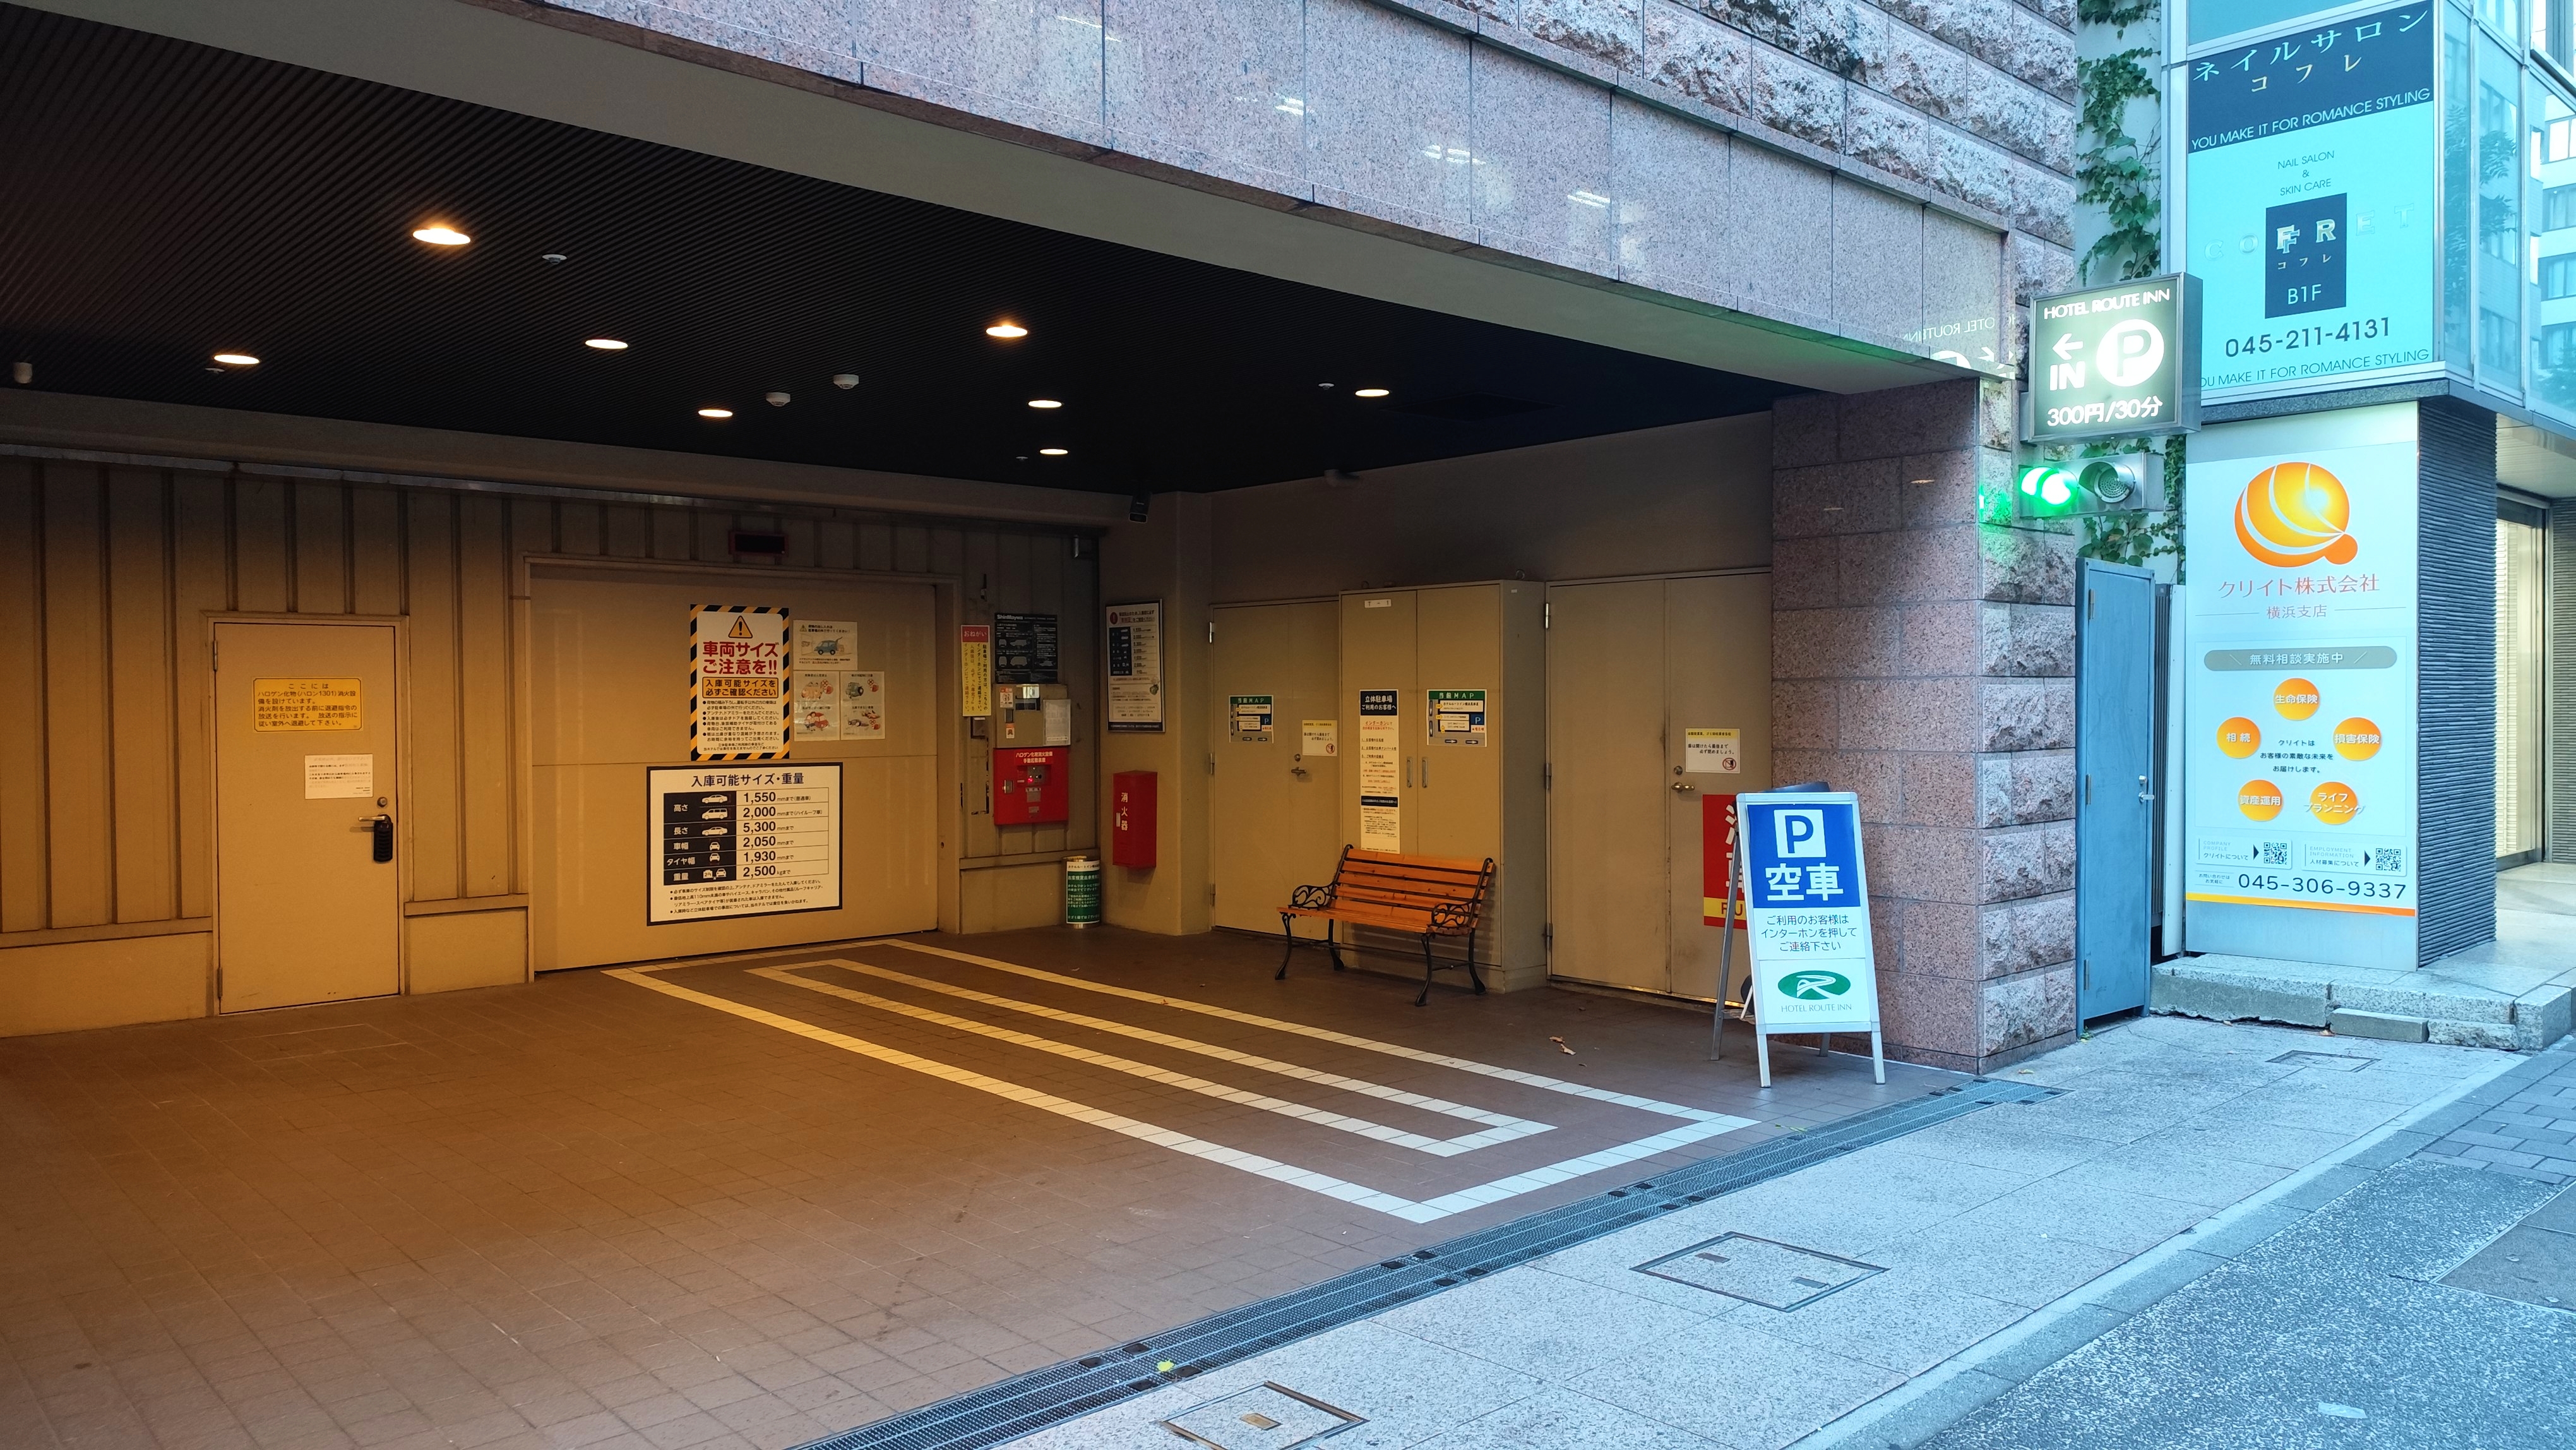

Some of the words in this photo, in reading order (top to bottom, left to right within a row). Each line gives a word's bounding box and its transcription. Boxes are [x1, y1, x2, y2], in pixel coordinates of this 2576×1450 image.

[2193, 9, 2428, 81] ネイルサロン
[2251, 54, 2361, 92] コフレ
[2191, 135, 2217, 150] YOU
[2221, 128, 2254, 144] MAKE
[2258, 123, 2268, 136] IT
[2272, 117, 2298, 133] FOR
[2303, 100, 2371, 126] ROMANCE
[2376, 88, 2430, 111] STYLING
[2277, 157, 2298, 169] NAIL
[2302, 150, 2334, 162] SALON
[2303, 169, 2310, 178] &
[2280, 184, 2301, 196] SKIN
[2305, 179, 2332, 191] CARE
[2277, 254, 2332, 270] コフレ
[2287, 284, 2322, 304] B1F
[2044, 301, 2089, 320] HOTEL
[2092, 293, 2140, 313] ROUTE
[2143, 289, 2169, 305] INN
[2226, 317, 2389, 357] 045-211-4131
[2219, 371, 2251, 385] MAKE
[2257, 369, 2266, 380] IT
[2270, 366, 2296, 378] FOR
[2301, 356, 2370, 375] ROMANCE
[2375, 349, 2429, 366] STYLING
[2050, 361, 2085, 391] IN
[2047, 395, 2162, 426] 300円/30分
[2219, 573, 2380, 598] クリイト株式会社
[2267, 604, 2327, 620] 横浜支店
[703, 641, 779, 657] 車両サイズ
[2250, 652, 2344, 665] 無料相談実施中
[703, 659, 777, 675] ご注意を!!
[706, 679, 776, 688] 入庫可能サイズを
[706, 688, 776, 697] 必ずご確認ください
[1365, 695, 1393, 703] 立体駐車場
[2275, 694, 2318, 704] 生命保険
[2226, 733, 2251, 743] 相続
[2335, 734, 2380, 744] 損害保険
[691, 772, 804, 788] 入庫可能サイズ・重量
[744, 792, 776, 805] 1,550
[2240, 794, 2281, 806] 資産運用
[2318, 792, 2348, 802] ライフ
[673, 803, 689, 812] 高さ
[742, 806, 776, 820] 2,000
[742, 821, 776, 834] 5,300
[1785, 815, 1814, 853] P
[742, 836, 776, 849] 2,050
[667, 857, 695, 866] タイヤ幅
[743, 851, 776, 863] 1,930
[2203, 853, 2249, 861] クリイトについて
[2310, 859, 2359, 867] 人材募集について
[742, 865, 776, 878] 2,500
[1765, 863, 1844, 901] 空車
[2238, 873, 2406, 899] 045-306-9337
[1767, 914, 1849, 926] ご利用のお客様は
[1761, 927, 1857, 938] インターホンを押して
[1780, 941, 1841, 952] ご連絡下さい
